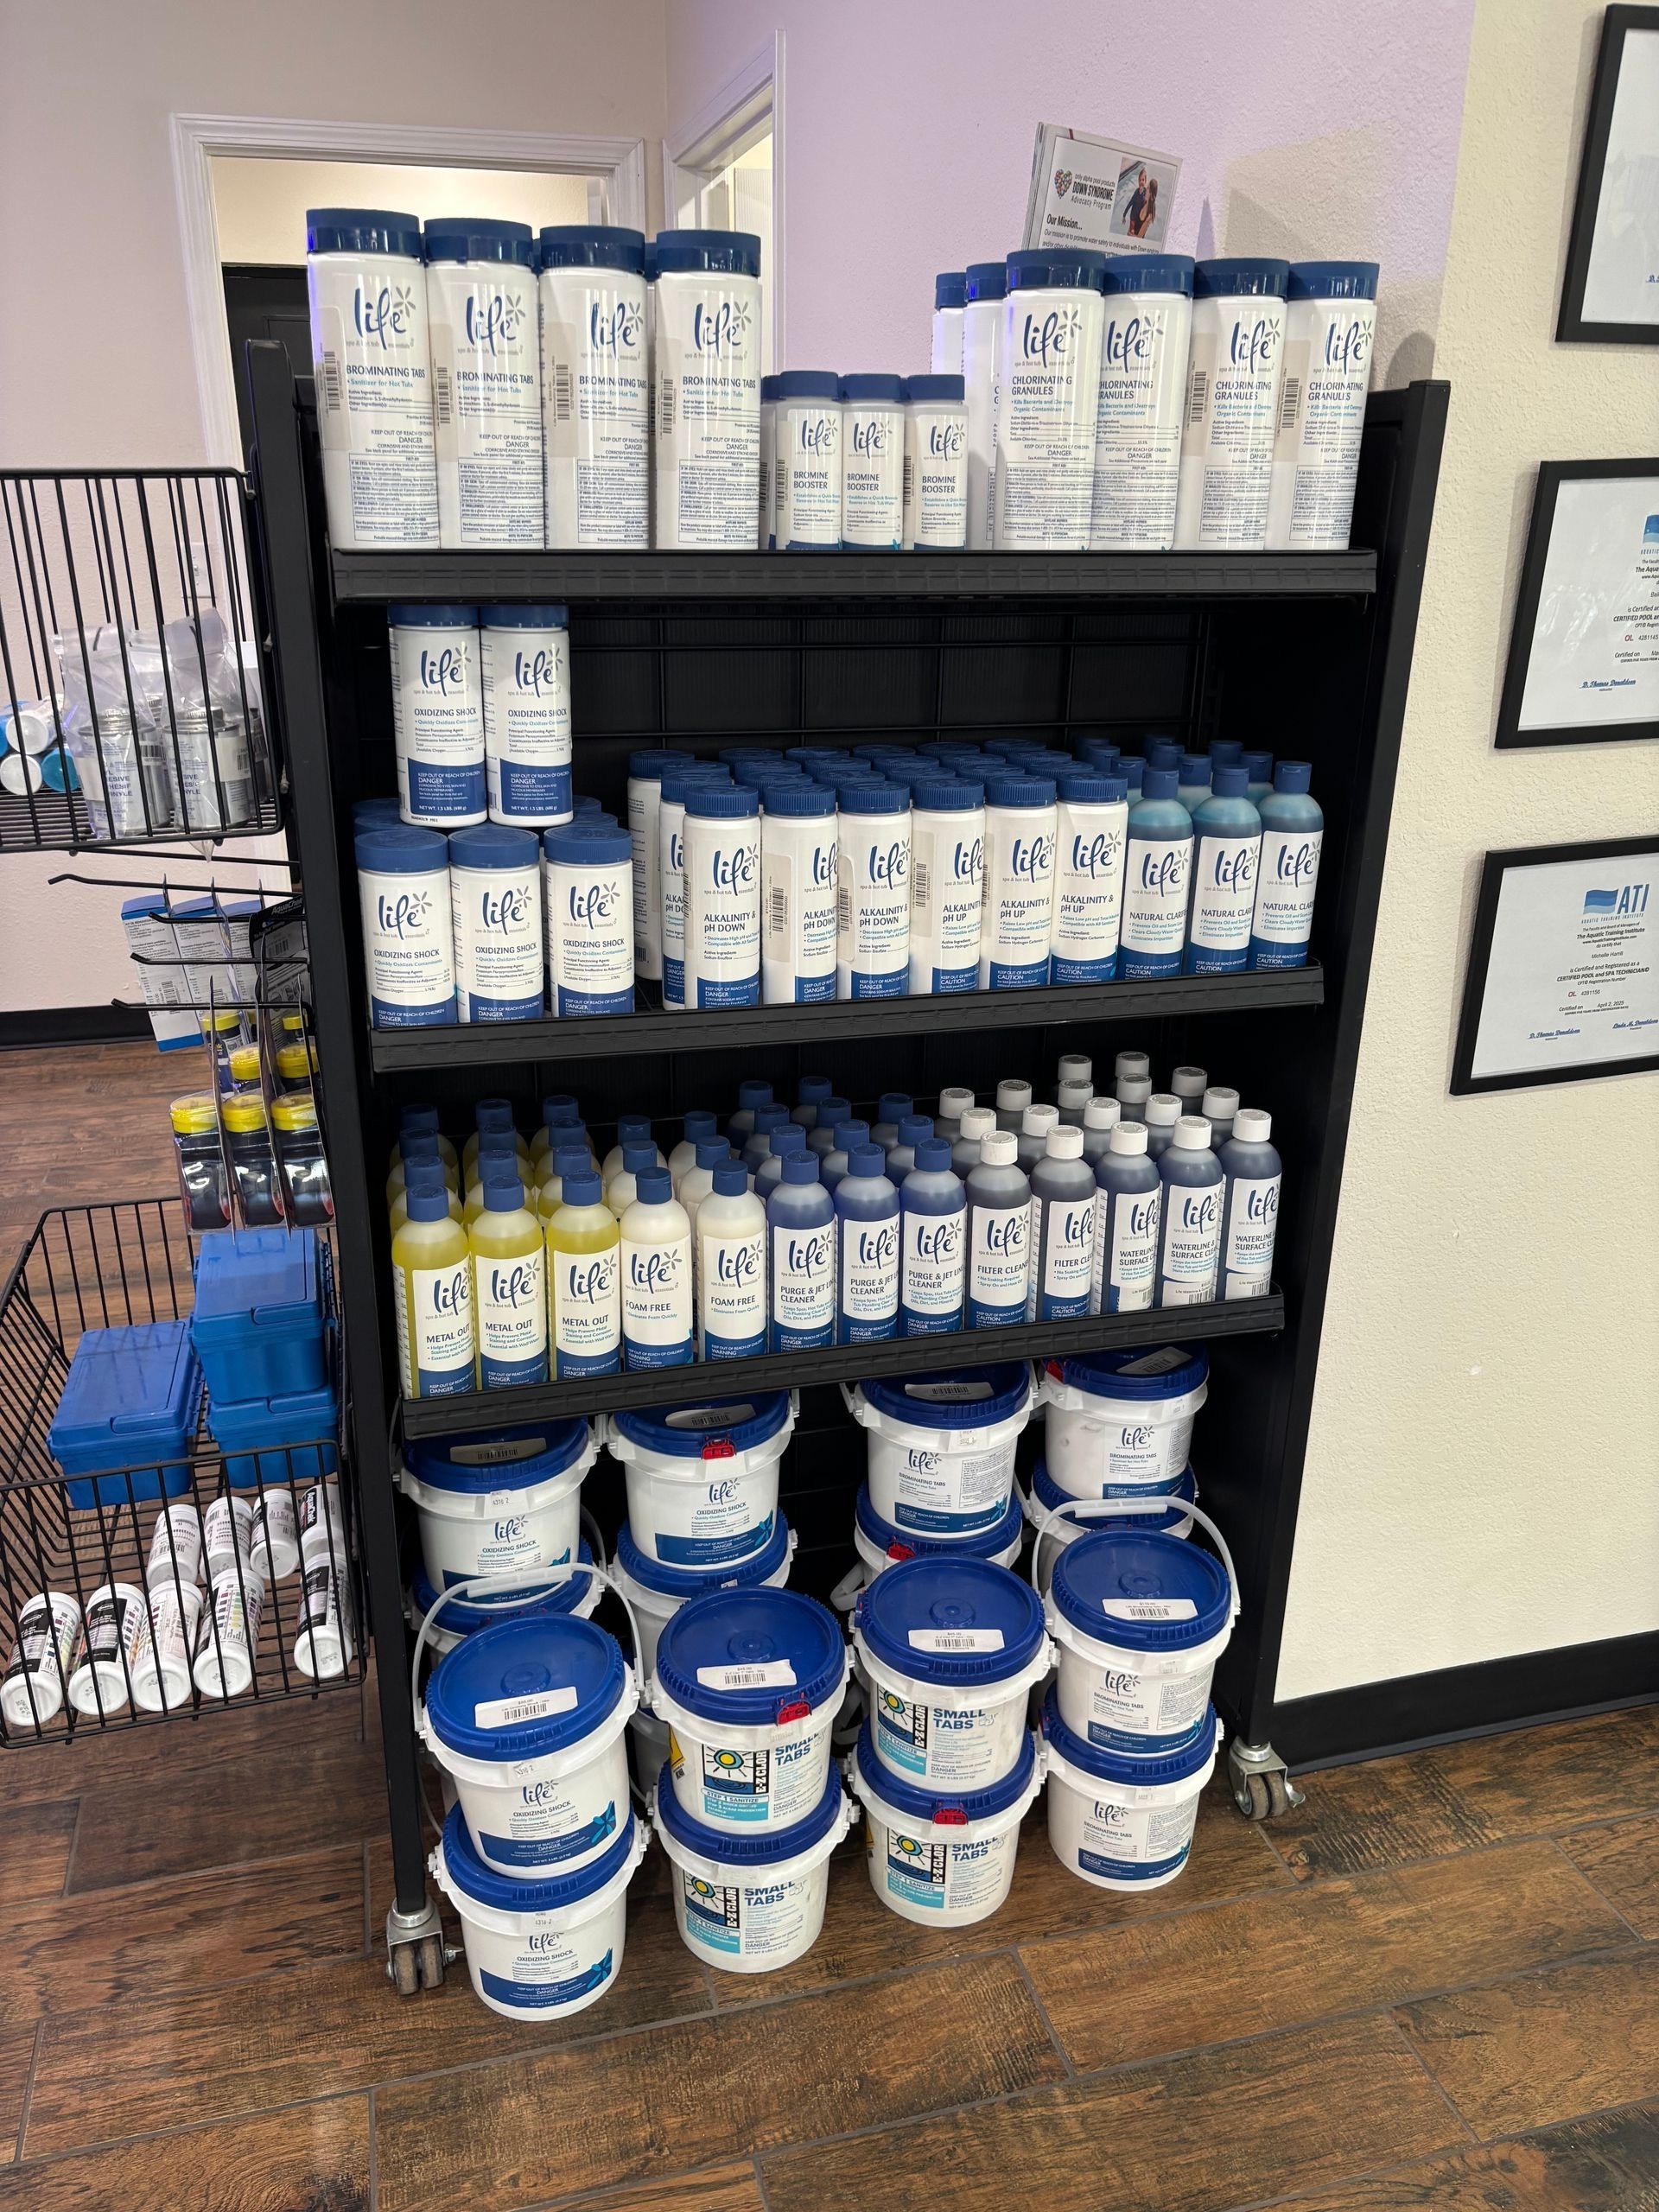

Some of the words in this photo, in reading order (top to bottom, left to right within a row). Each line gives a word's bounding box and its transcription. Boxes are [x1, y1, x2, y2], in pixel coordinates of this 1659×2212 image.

[1072, 181, 1088, 194] DOWN
[1088, 184, 1115, 201] SYNDROME
[1071, 195, 1092, 207] Advocacy
[1093, 199, 1112, 211] Program
[1046, 213, 1057, 226] Our
[354, 287, 406, 350] life
[694, 302, 741, 358] life
[1024, 311, 1067, 368] life
[1231, 320, 1272, 373] life
[1325, 320, 1364, 374] life
[346, 365, 410, 377] BROMINATING
[411, 367, 425, 378] TABS
[457, 372, 518, 384] BROMINATING
[520, 374, 534, 384] TABS
[683, 376, 741, 388] BROMINATING
[743, 378, 756, 389] TABS
[1012, 375, 1072, 386] CHLORINATING
[1011, 385, 1053, 396] GRANULES
[1216, 380, 1272, 391] CHLORINATING
[1309, 381, 1363, 391] CHLORINATING
[1215, 391, 1258, 401] GRANULES
[1308, 392, 1351, 402] GRANULES
[801, 419, 831, 456] life
[854, 422, 884, 459] life
[930, 425, 960, 461] life
[794, 471, 829, 480] BROMINE
[847, 473, 880, 481] BROMINE
[922, 475, 956, 484] BROMINE
[793, 480, 828, 489] BOOSTER
[847, 483, 879, 492] BOOSTER
[921, 485, 955, 493] BOOSTER
[421, 649, 464, 697] life
[515, 651, 556, 698] life
[415, 708, 454, 717] OXIDIZING
[455, 708, 477, 716] SHOCK
[508, 709, 548, 719] OXIDIZING
[1012, 836, 1050, 883] life
[1072, 834, 1113, 880] life
[869, 842, 906, 890] life
[1276, 843, 1313, 888] life
[712, 848, 753, 896] life
[1141, 851, 1181, 898] life
[1001, 898, 1045, 908] ALKALINITY
[1061, 894, 1106, 905] ALKALINITY
[1108, 894, 1114, 903] &
[1618, 884, 1649, 914] ATI
[570, 885, 611, 930] life
[860, 906, 904, 916] ALKALINITY
[1060, 906, 1071, 914] pH
[1073, 904, 1084, 912] UP
[1263, 902, 1297, 911] NATURAL
[378, 895, 422, 940] life
[704, 912, 750, 922] ALKALINITY
[1000, 911, 1011, 919] pH
[1014, 910, 1026, 918] UP
[1129, 912, 1164, 921] NATURAL
[1201, 908, 1236, 918] NATURAL
[860, 918, 870, 927] pH
[874, 916, 899, 925] DOWN
[704, 925, 715, 933] pH
[718, 923, 745, 932] DOWN
[563, 939, 600, 948] OXIDIZING
[602, 938, 624, 947] SHOCK
[374, 949, 412, 959] OXIDIZING
[414, 949, 440, 958] SHOCK
[1574, 964, 1594, 973] Certified
[1183, 1196, 1216, 1235] life
[987, 1217, 1023, 1257] life
[1236, 1233, 1271, 1243] WATERLINE
[917, 1224, 955, 1265] life
[1171, 1242, 1209, 1251] WATERLINE
[1235, 1242, 1266, 1250] SURFACE
[789, 1237, 826, 1279] life
[1171, 1250, 1202, 1259] SURFACE
[717, 1247, 757, 1288] life
[1054, 1258, 1079, 1268] FILTER
[631, 1253, 671, 1294] life
[909, 1270, 933, 1281] PURGE
[942, 1271, 953, 1281] JET
[977, 1265, 1002, 1274] FILTER
[492, 1266, 533, 1308] life
[569, 1262, 610, 1305] life
[850, 1278, 877, 1287] PURGE
[885, 1275, 893, 1286] JET
[909, 1278, 942, 1288] CLEANER
[850, 1287, 884, 1295] CLEANER
[626, 1300, 647, 1312] FOAM
[650, 1302, 671, 1311] FREE
[711, 1297, 734, 1306] FOAM
[737, 1295, 756, 1306] FREE
[486, 1322, 513, 1332] METAL
[516, 1319, 533, 1331] OUT
[563, 1317, 587, 1326] METAL
[589, 1314, 608, 1325] OUT
[427, 1332, 454, 1344] METAL
[457, 1323, 469, 1338] OUT
[1122, 1427, 1147, 1451] life
[909, 1449, 934, 1475] life
[709, 1482, 734, 1504] life
[696, 1507, 728, 1516] OXIDIZING
[728, 1502, 747, 1512] SHOCK
[1105, 1670, 1132, 1696] life
[1094, 1692, 1130, 1707] BROMINATING
[933, 1707, 986, 1719] SMALL
[933, 1718, 974, 1730] TABS
[523, 1783, 552, 1807] life
[513, 1807, 547, 1817] OXIDIZING
[548, 1800, 571, 1812] SHOCK
[1094, 1801, 1120, 1826] life
[745, 1881, 796, 1897] SMALL
[745, 1892, 785, 1906] TABS
[551, 1949, 574, 1959] SHOCK
